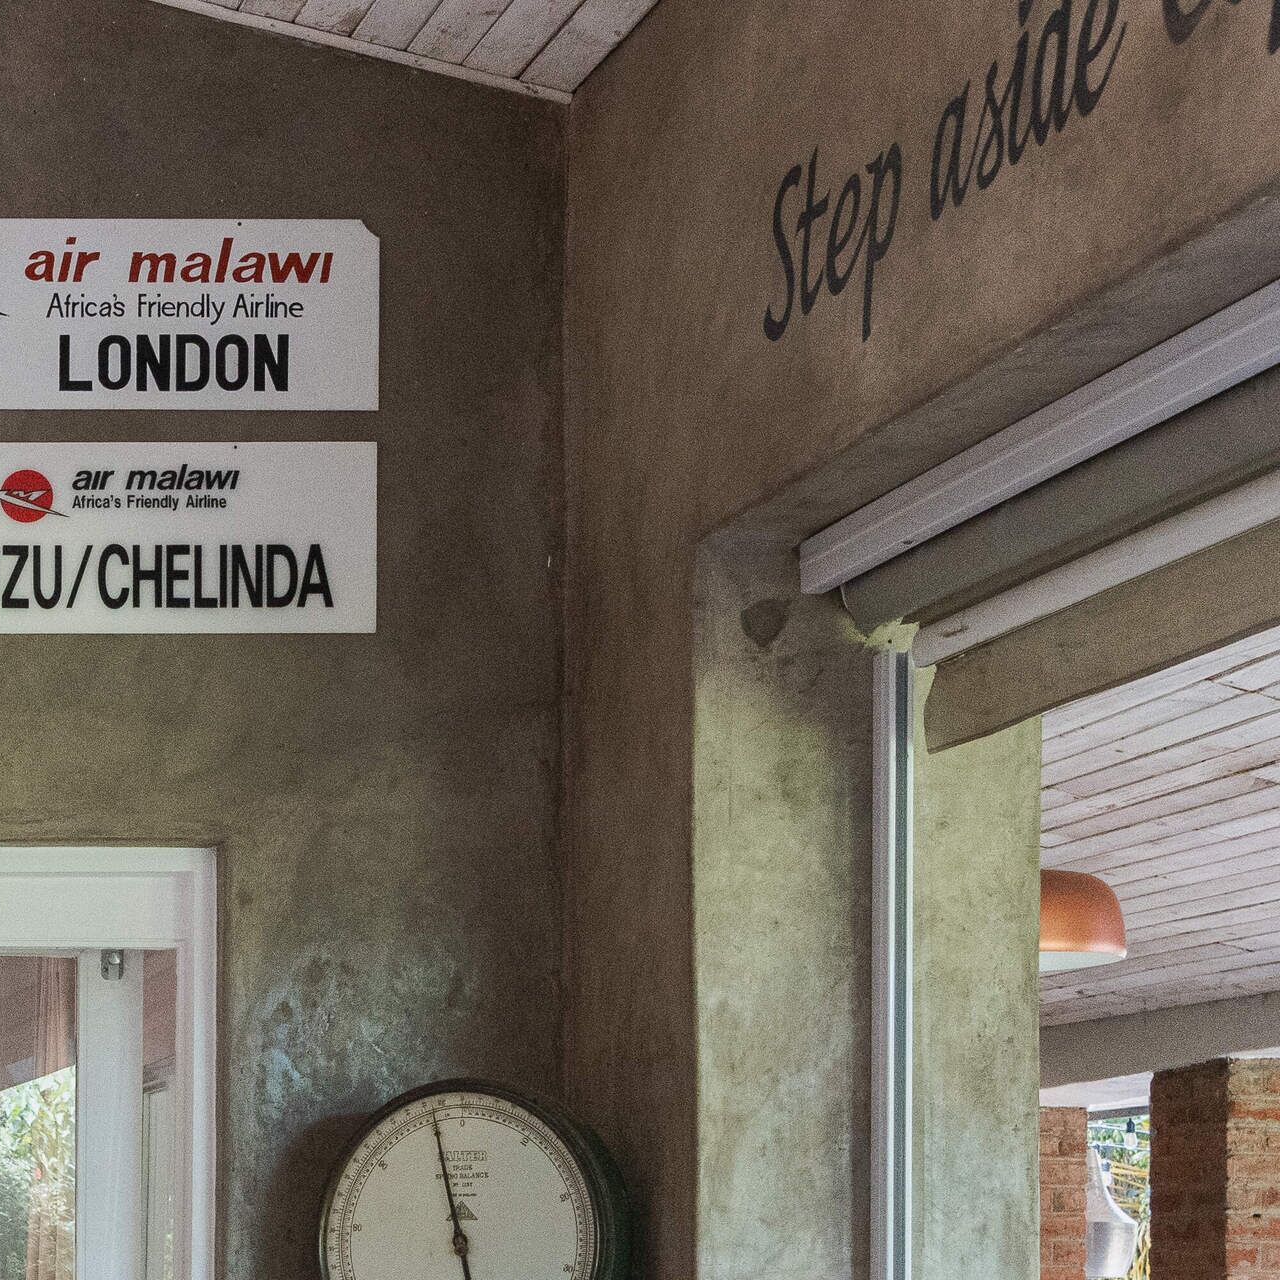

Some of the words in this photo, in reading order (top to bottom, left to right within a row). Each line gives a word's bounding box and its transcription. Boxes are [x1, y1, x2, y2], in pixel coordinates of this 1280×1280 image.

[763, 142, 903, 342] Step
[930, 0, 1129, 221] aside
[24, 237, 101, 284] air
[46, 292, 125, 319] Africa's
[137, 292, 226, 325] Friendly
[232, 292, 304, 319] Airline
[58, 333, 289, 393] LONDON
[71, 494, 122, 509] Africa's
[127, 494, 179, 512] Friendly
[185, 494, 227, 509] Airline
